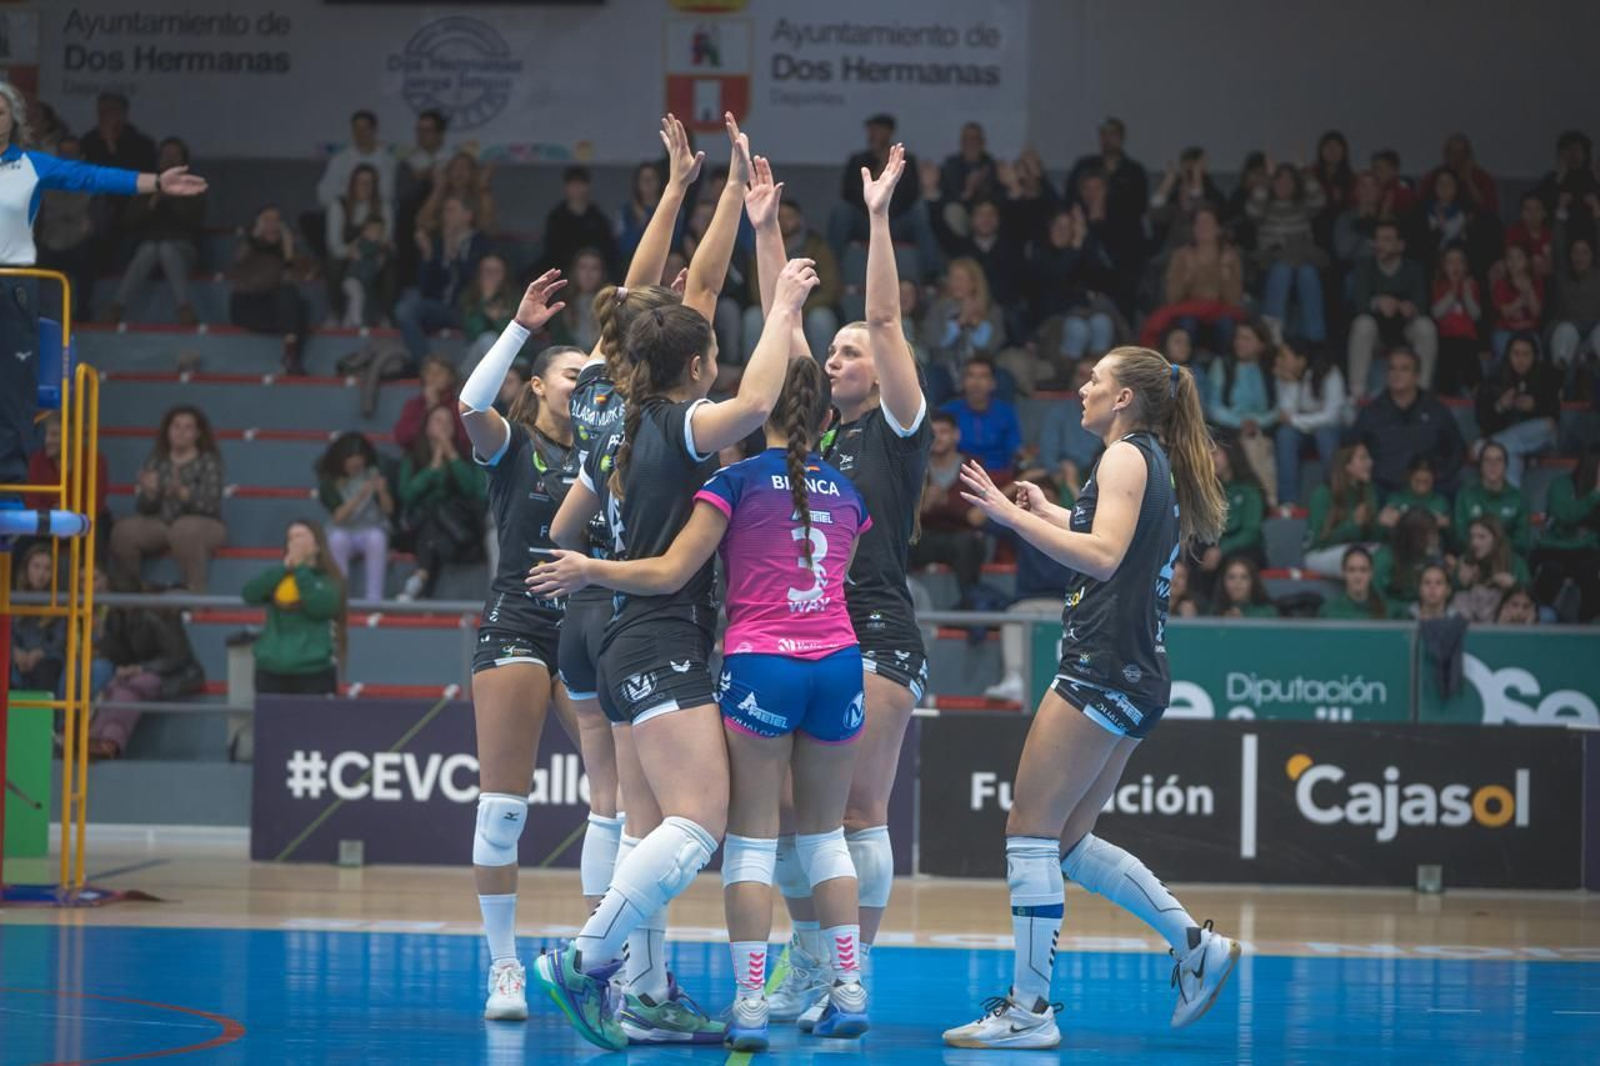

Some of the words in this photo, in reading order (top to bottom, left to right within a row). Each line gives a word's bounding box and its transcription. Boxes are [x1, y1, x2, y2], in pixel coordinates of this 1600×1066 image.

[62, 8, 250, 40] Ayuntamiento
[256, 11, 291, 36] de
[771, 17, 959, 50] Ayuntamiento
[965, 21, 1001, 48] de
[63, 44, 124, 71] Dos
[134, 46, 291, 73] Hermanas
[771, 53, 833, 82] Dos
[841, 56, 1001, 87] Hermanas
[771, 475, 840, 497] BINCA
[787, 526, 829, 602] 3
[1226, 672, 1387, 705] Diputación
[286, 750, 591, 805] #CEVCall
[971, 772, 1214, 815] Fución
[1296, 765, 1530, 841] Cajasol
